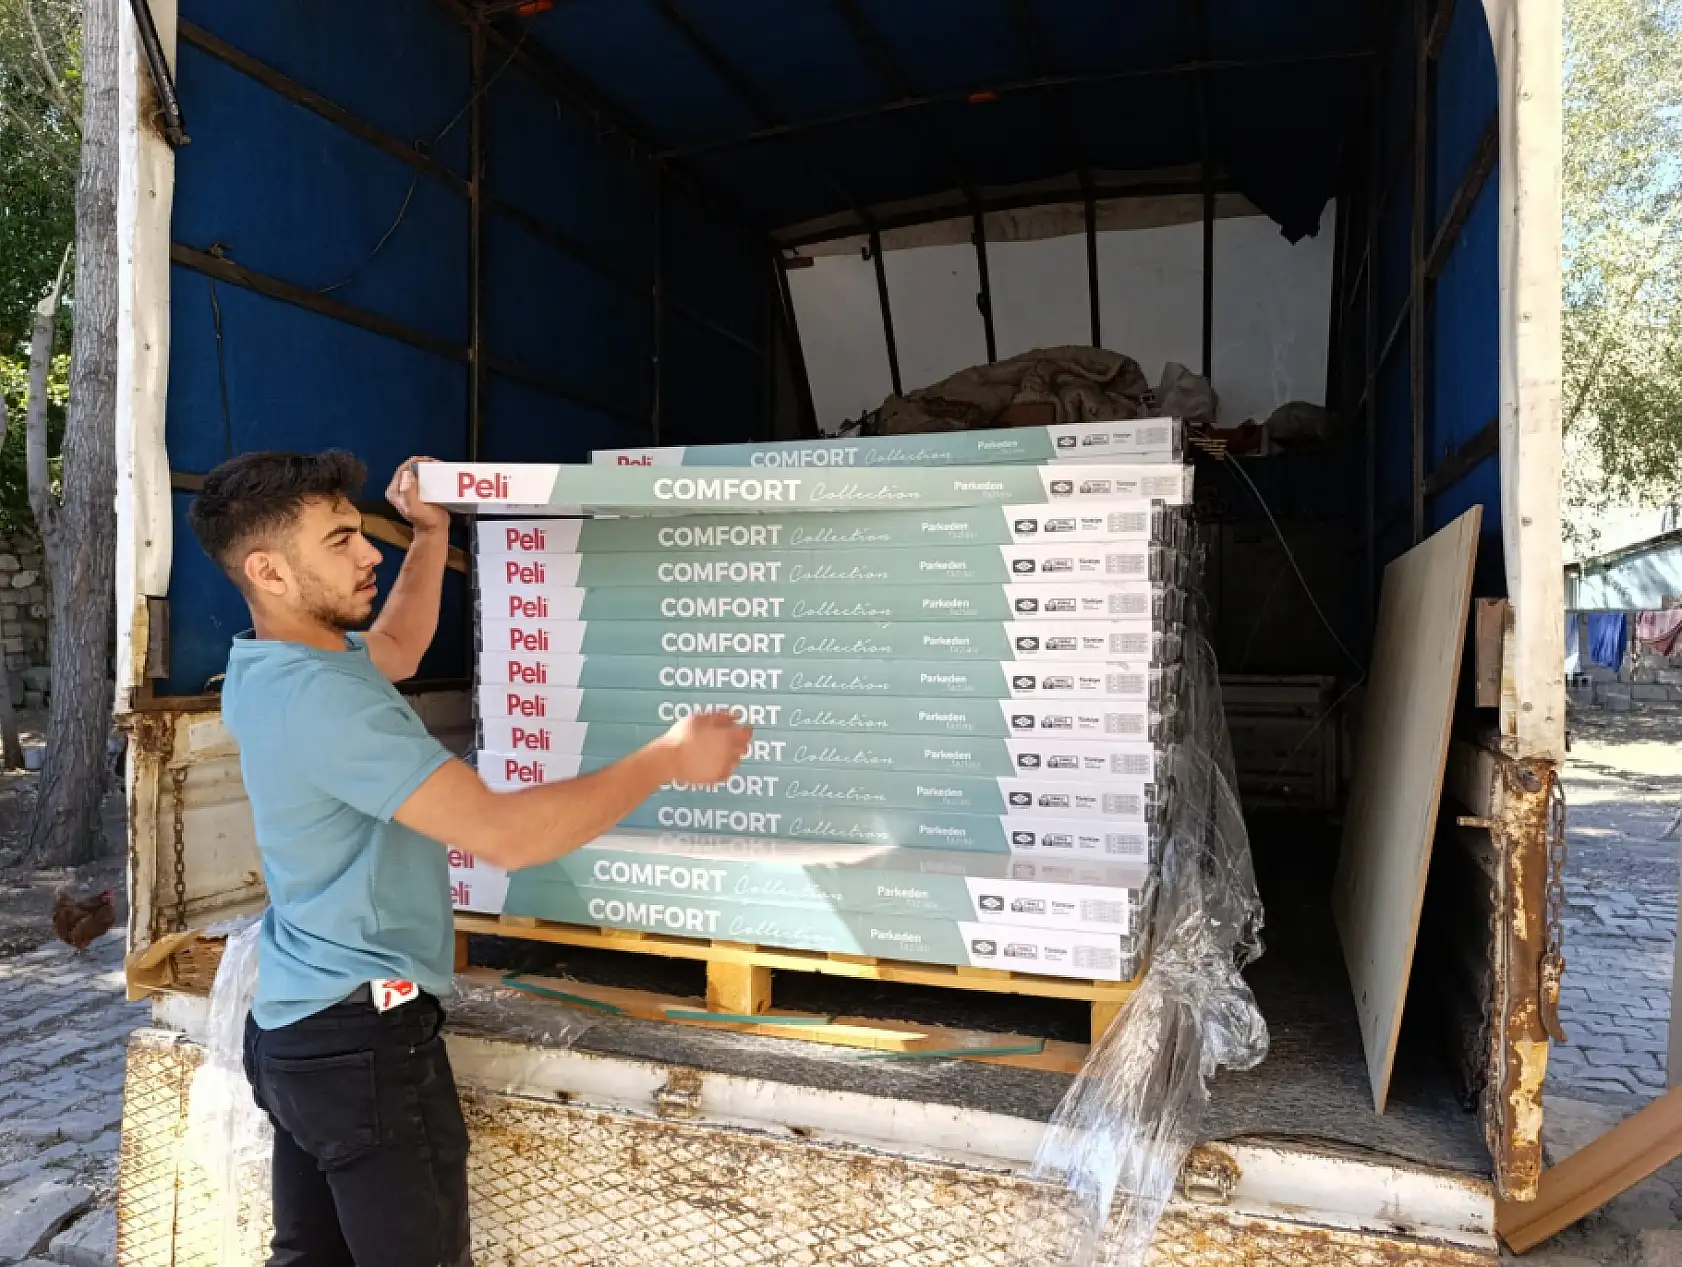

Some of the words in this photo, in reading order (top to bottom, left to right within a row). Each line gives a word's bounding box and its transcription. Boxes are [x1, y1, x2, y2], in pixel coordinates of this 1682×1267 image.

[751, 447, 859, 468] COMFORT
[456, 471, 508, 499] Peli
[653, 476, 801, 502] COMFORT
[810, 482, 921, 503] Collection
[505, 527, 545, 551] Peli
[658, 524, 784, 548] COMFORT
[788, 527, 891, 546] Collection
[506, 561, 545, 584] Peli
[658, 560, 782, 584] COMFORT
[788, 565, 888, 582] Collection
[508, 595, 548, 618] Peli
[660, 596, 784, 619] COMFORT
[790, 600, 892, 618] Collection
[509, 627, 549, 651] Peli
[661, 631, 786, 655] COMFORT
[790, 635, 893, 656] Collection
[508, 660, 547, 685] Peli
[658, 667, 783, 690] COMFORT
[789, 672, 890, 691] Collection
[506, 693, 547, 718] Peli
[787, 707, 888, 730] Collection
[511, 726, 551, 751] Peli
[792, 741, 894, 765] Collection
[504, 759, 545, 784] Peli
[786, 781, 887, 801] Collection
[658, 807, 782, 835] COMFORT
[787, 816, 890, 840] Collection
[593, 859, 728, 893] COMFORT
[588, 898, 722, 933] COMFORT
